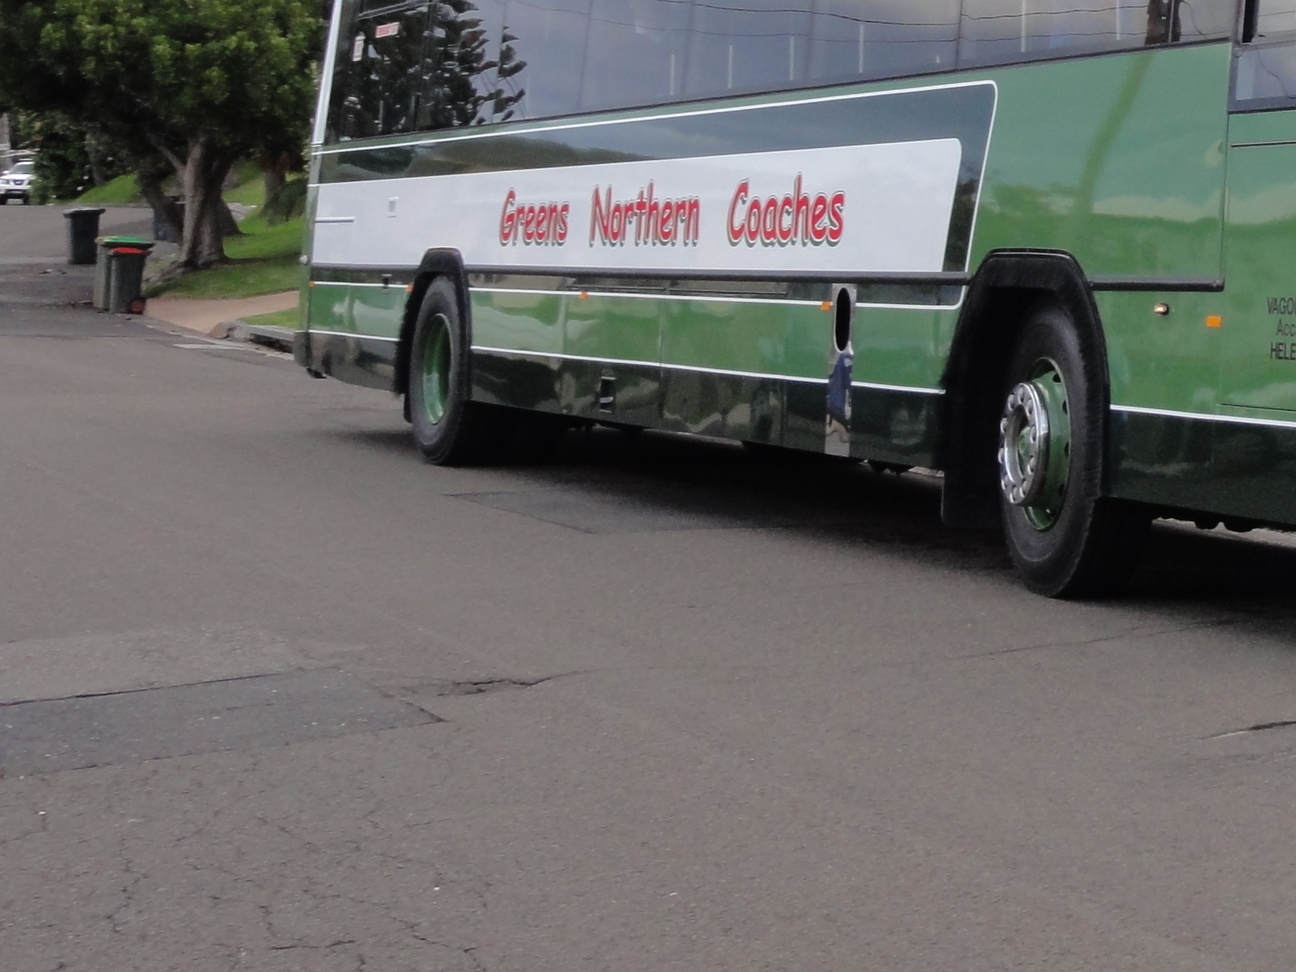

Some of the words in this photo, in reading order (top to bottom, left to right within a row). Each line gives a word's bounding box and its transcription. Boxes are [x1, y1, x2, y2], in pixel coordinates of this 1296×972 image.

[500, 187, 570, 247] Greens
[588, 179, 700, 247] Northern
[727, 171, 846, 247] Coaches
